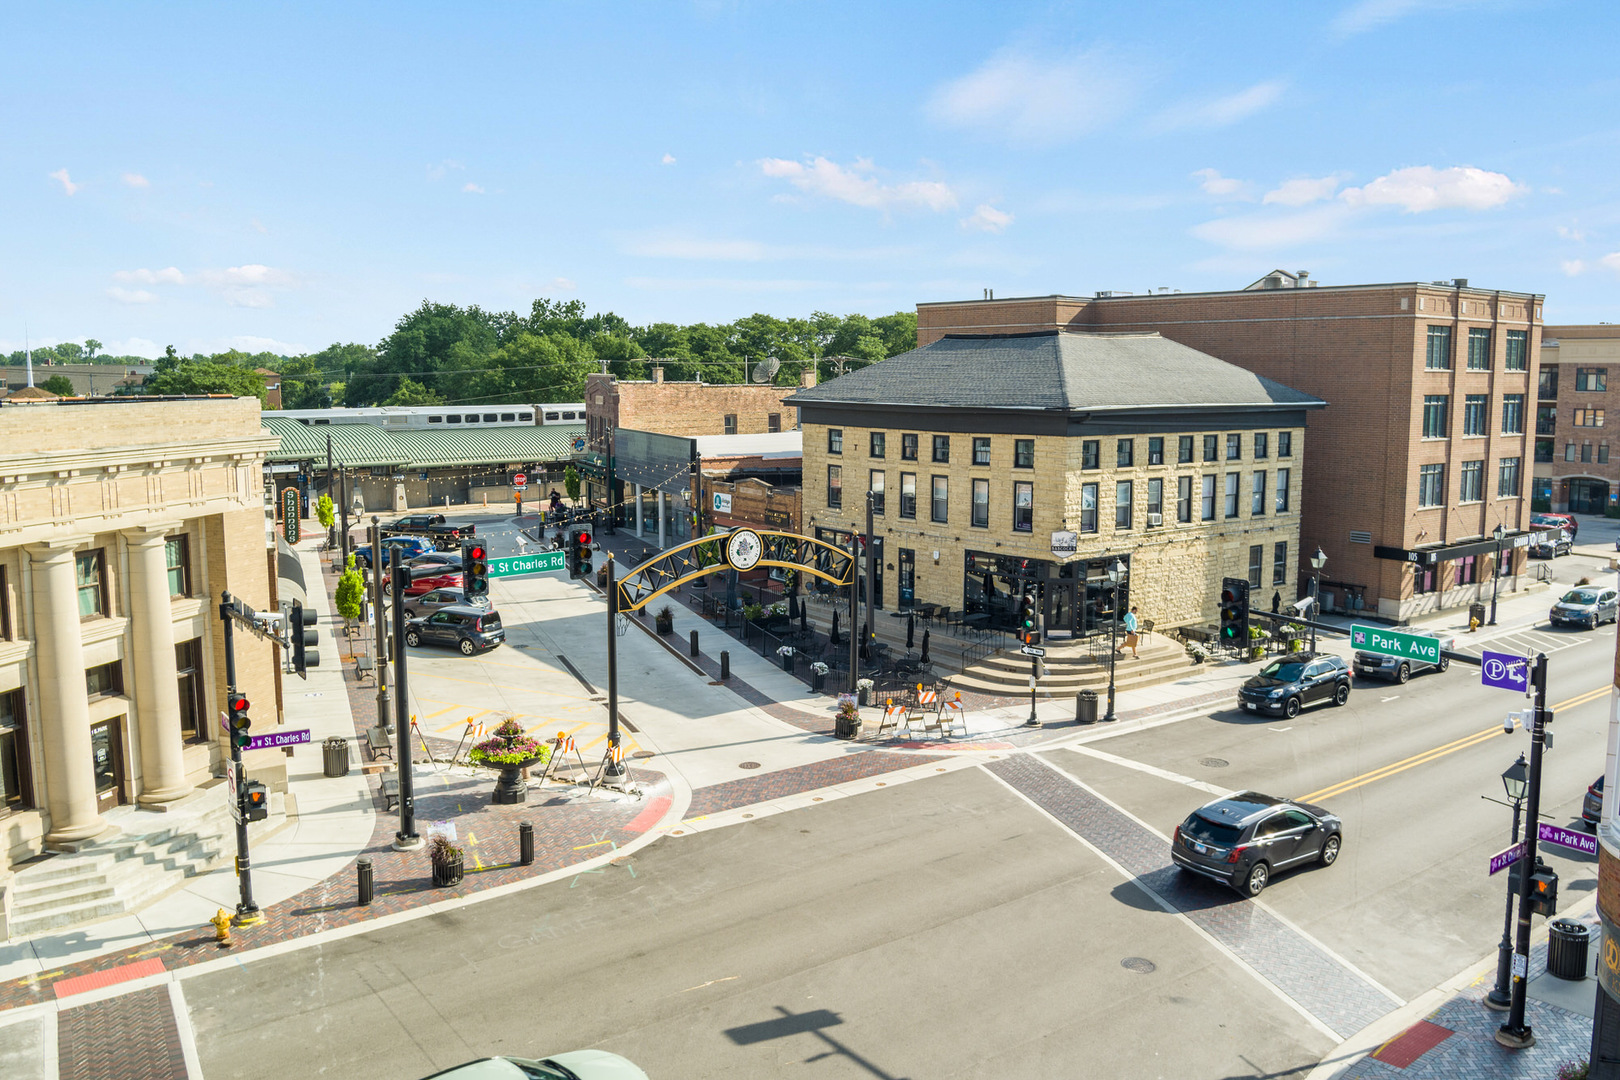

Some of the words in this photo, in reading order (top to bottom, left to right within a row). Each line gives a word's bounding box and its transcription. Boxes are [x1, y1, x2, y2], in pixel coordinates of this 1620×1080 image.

[498, 562, 509, 573] St
[512, 559, 548, 572] Charles
[551, 556, 563, 567] Rd
[1408, 552, 1418, 561] 105
[1371, 634, 1402, 652] Park
[1409, 641, 1436, 657] Ave
[264, 736, 275, 746] St.
[275, 733, 300, 745] Charles
[301, 732, 310, 742] Rd
[1554, 832, 1559, 841] N
[1560, 831, 1578, 846] Park
[1580, 837, 1595, 851] Ave
